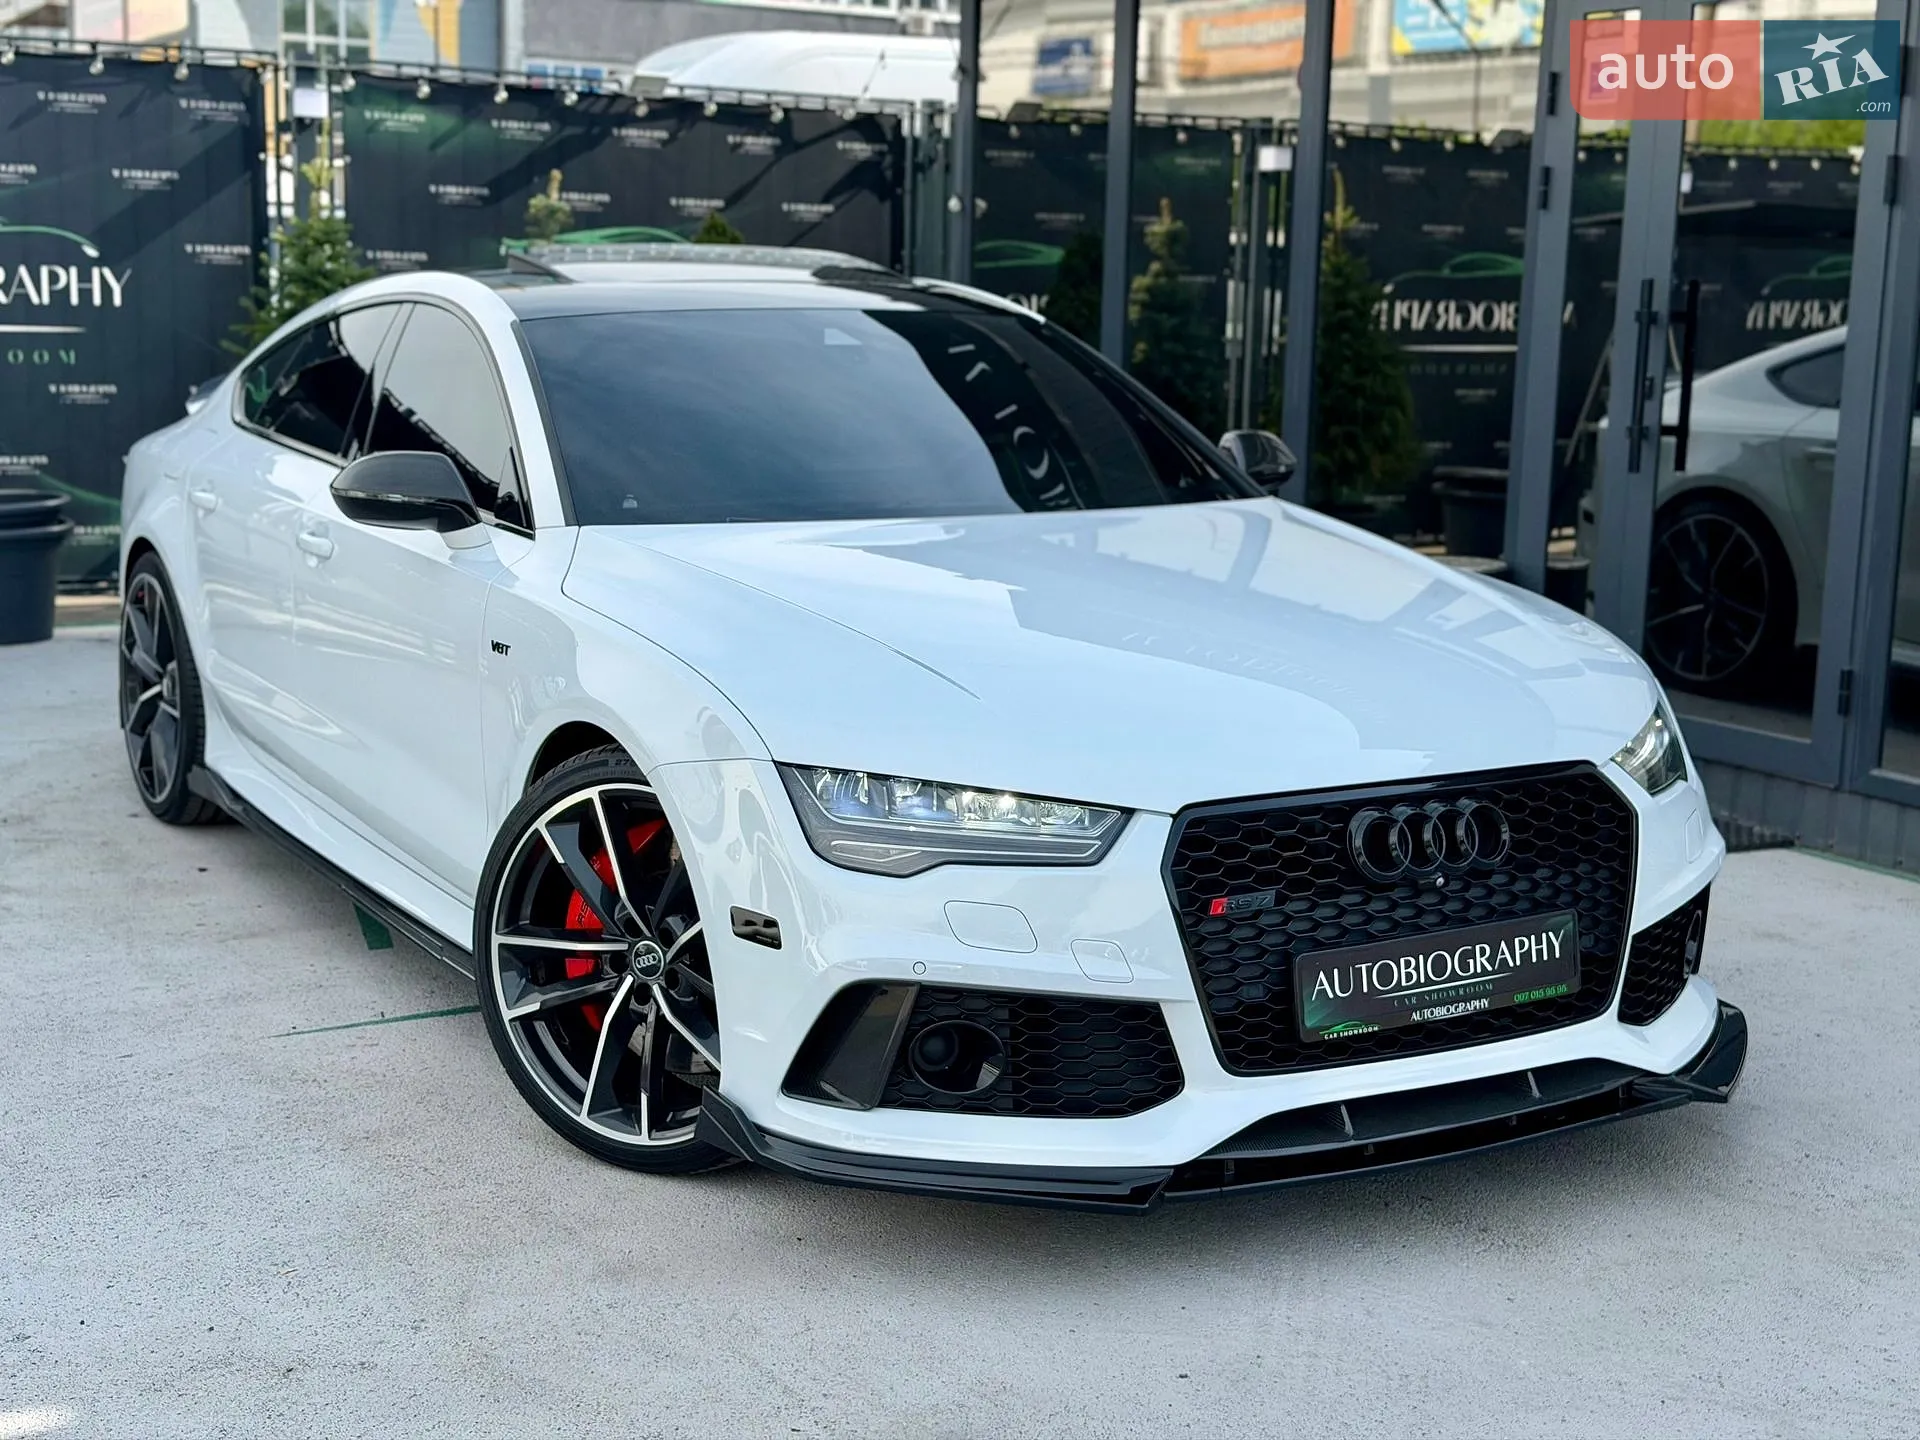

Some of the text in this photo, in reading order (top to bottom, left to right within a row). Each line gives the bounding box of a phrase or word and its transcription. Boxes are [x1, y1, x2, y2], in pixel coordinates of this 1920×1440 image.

[0, 263, 132, 308] APHY
[1311, 929, 1564, 1001] AUTOBIOGRAPHY
[1424, 983, 1493, 1001] SHOWROOM
[1411, 998, 1489, 1021] AUTOBIOGRAPHY
